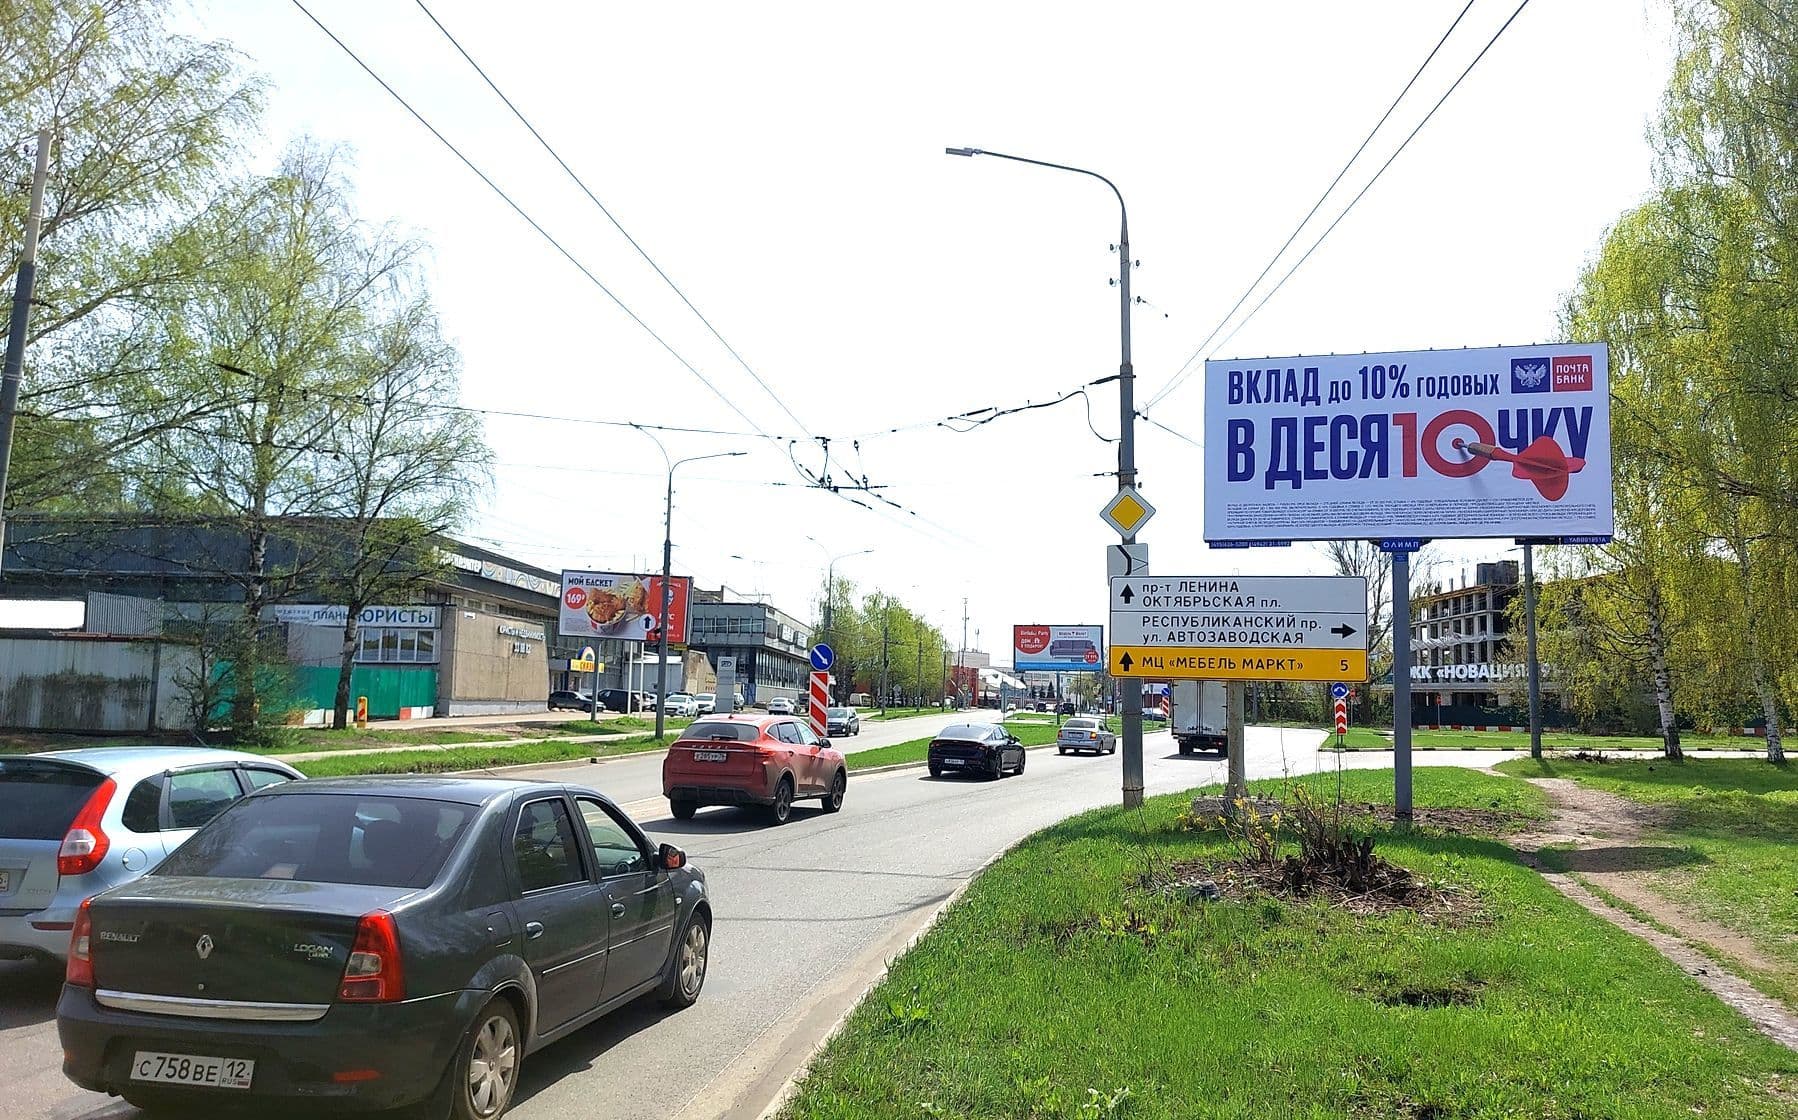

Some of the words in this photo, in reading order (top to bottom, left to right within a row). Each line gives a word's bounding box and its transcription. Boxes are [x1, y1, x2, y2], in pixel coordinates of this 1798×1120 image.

[1556, 363, 1589, 374] ПОЧТА
[1228, 367, 1321, 407] ВКЛАД
[1358, 364, 1410, 400] 10%
[1556, 374, 1585, 384] БАНК
[1227, 418, 1256, 482] В
[1383, 541, 1419, 549] ОЛИМП
[568, 576, 584, 586] МОЙ
[586, 578, 613, 587] БАСКЕТ
[1142, 584, 1171, 594] пр-т
[1178, 581, 1239, 593] ЛЕНИНА
[1142, 596, 1255, 608] ОКТЯБРЬСКАЯ
[1260, 598, 1281, 609] пл.
[358, 609, 432, 623] ЮРИСТЫ
[1142, 614, 1296, 628] РЕСПУБЛИКАНСКИЙ
[1300, 620, 1322, 632] пр.
[1142, 634, 1162, 645] ул.
[1167, 632, 1304, 645] АВТОЗАВОДСКАЯ
[1142, 656, 1164, 669] МЦ
[1169, 656, 1236, 670] «МЕБЕЛЬ
[1242, 658, 1304, 671] МАРКТ»
[1340, 659, 1349, 671] 5
[100, 931, 140, 942] RENAULT
[294, 943, 333, 953] LOGAN
[226, 1060, 247, 1079] 12
[221, 1077, 238, 1085] RUS
